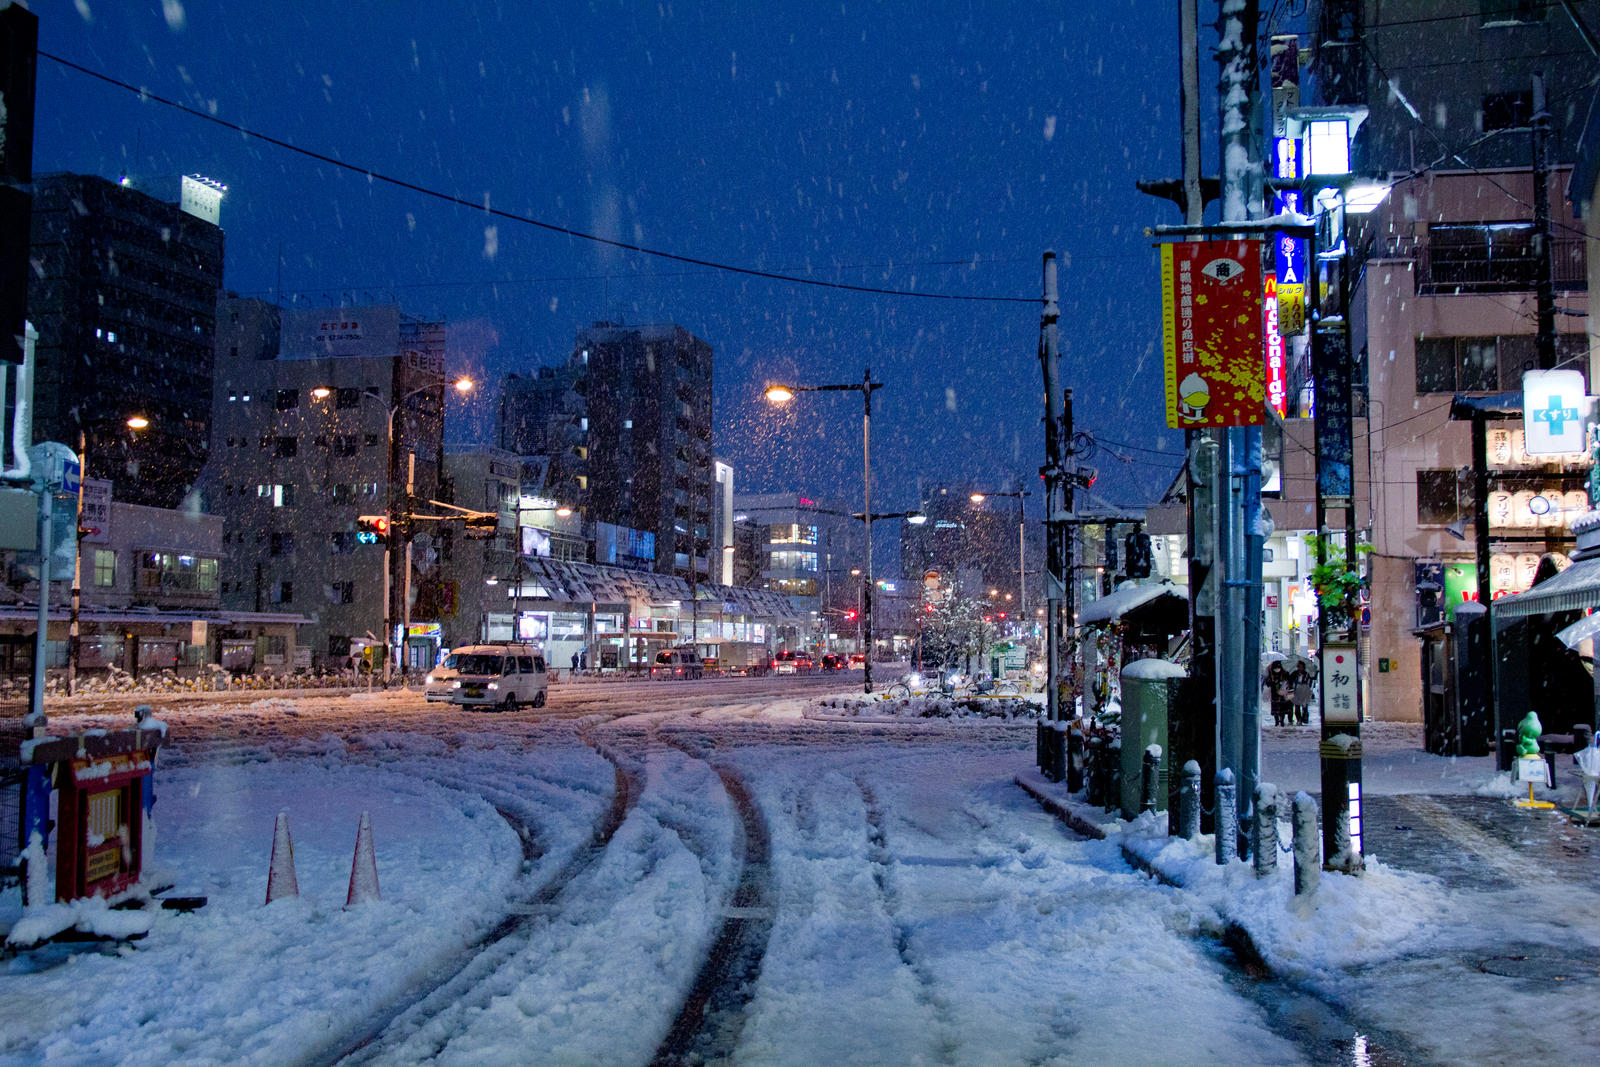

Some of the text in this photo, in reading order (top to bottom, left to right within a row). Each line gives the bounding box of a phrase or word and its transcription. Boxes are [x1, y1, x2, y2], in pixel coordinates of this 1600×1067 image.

[1215, 262, 1231, 278] 商
[1180, 260, 1195, 364] 巣鴨地蔵通り商店街
[1538, 409, 1572, 421] くすり
[1330, 670, 1350, 710] 初詣
